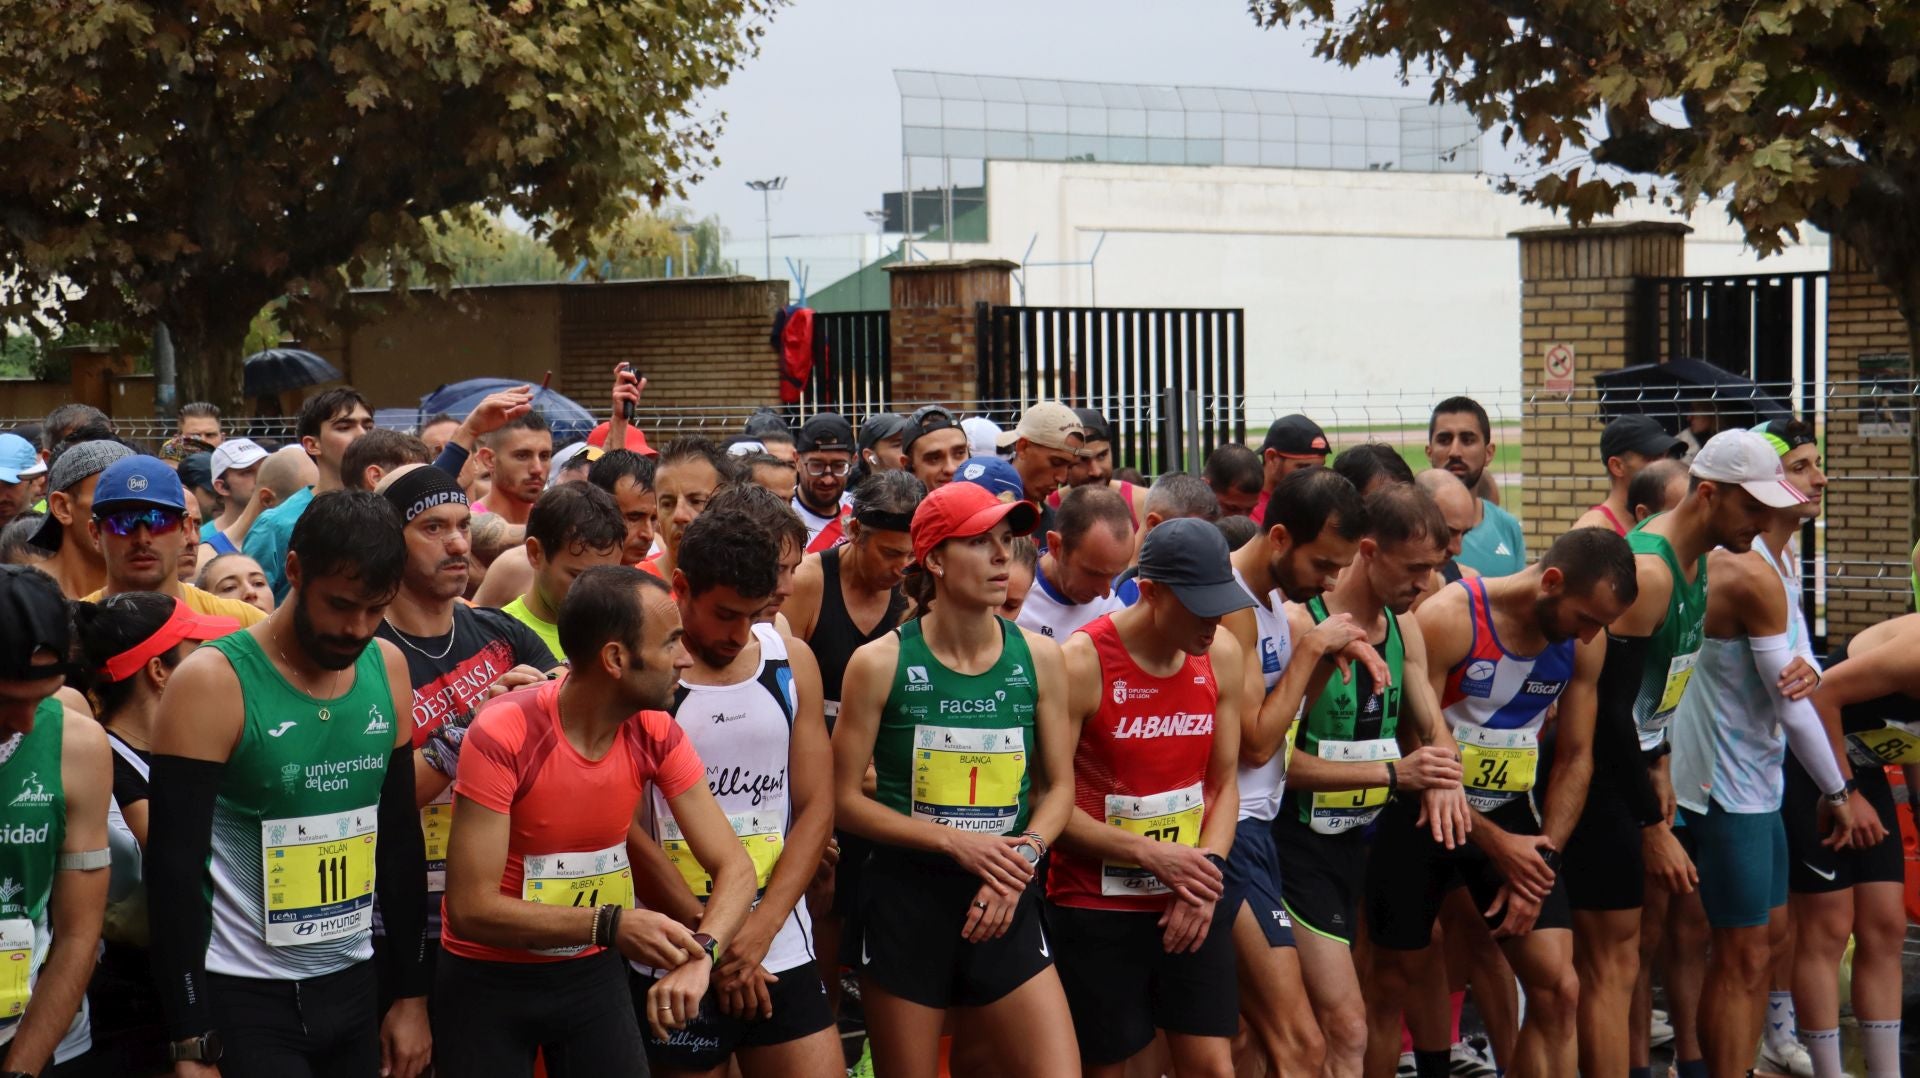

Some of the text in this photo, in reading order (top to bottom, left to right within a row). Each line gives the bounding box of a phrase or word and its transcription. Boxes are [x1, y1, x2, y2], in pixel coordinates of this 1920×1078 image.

[130, 478, 147, 489] Buff
[1526, 682, 1560, 694] Toscaf
[412, 660, 498, 729] DESPENSA
[945, 733, 952, 744] k
[1005, 735, 1010, 745] k
[1479, 731, 1485, 741] k
[1343, 746, 1349, 755] k
[305, 753, 384, 778] universidad
[960, 755, 992, 765] BLANCA
[1472, 758, 1509, 790] 34
[968, 766, 978, 805] 1
[1133, 802, 1140, 812] k
[356, 816, 362, 826] k
[752, 817, 759, 827] k
[955, 819, 1006, 830] HYUNDAI
[1148, 816, 1177, 829] JAVIER
[298, 825, 306, 835] k
[613, 852, 619, 862] k
[557, 859, 564, 870] k
[318, 855, 347, 904] 111
[320, 911, 362, 932] HYUNDAI
